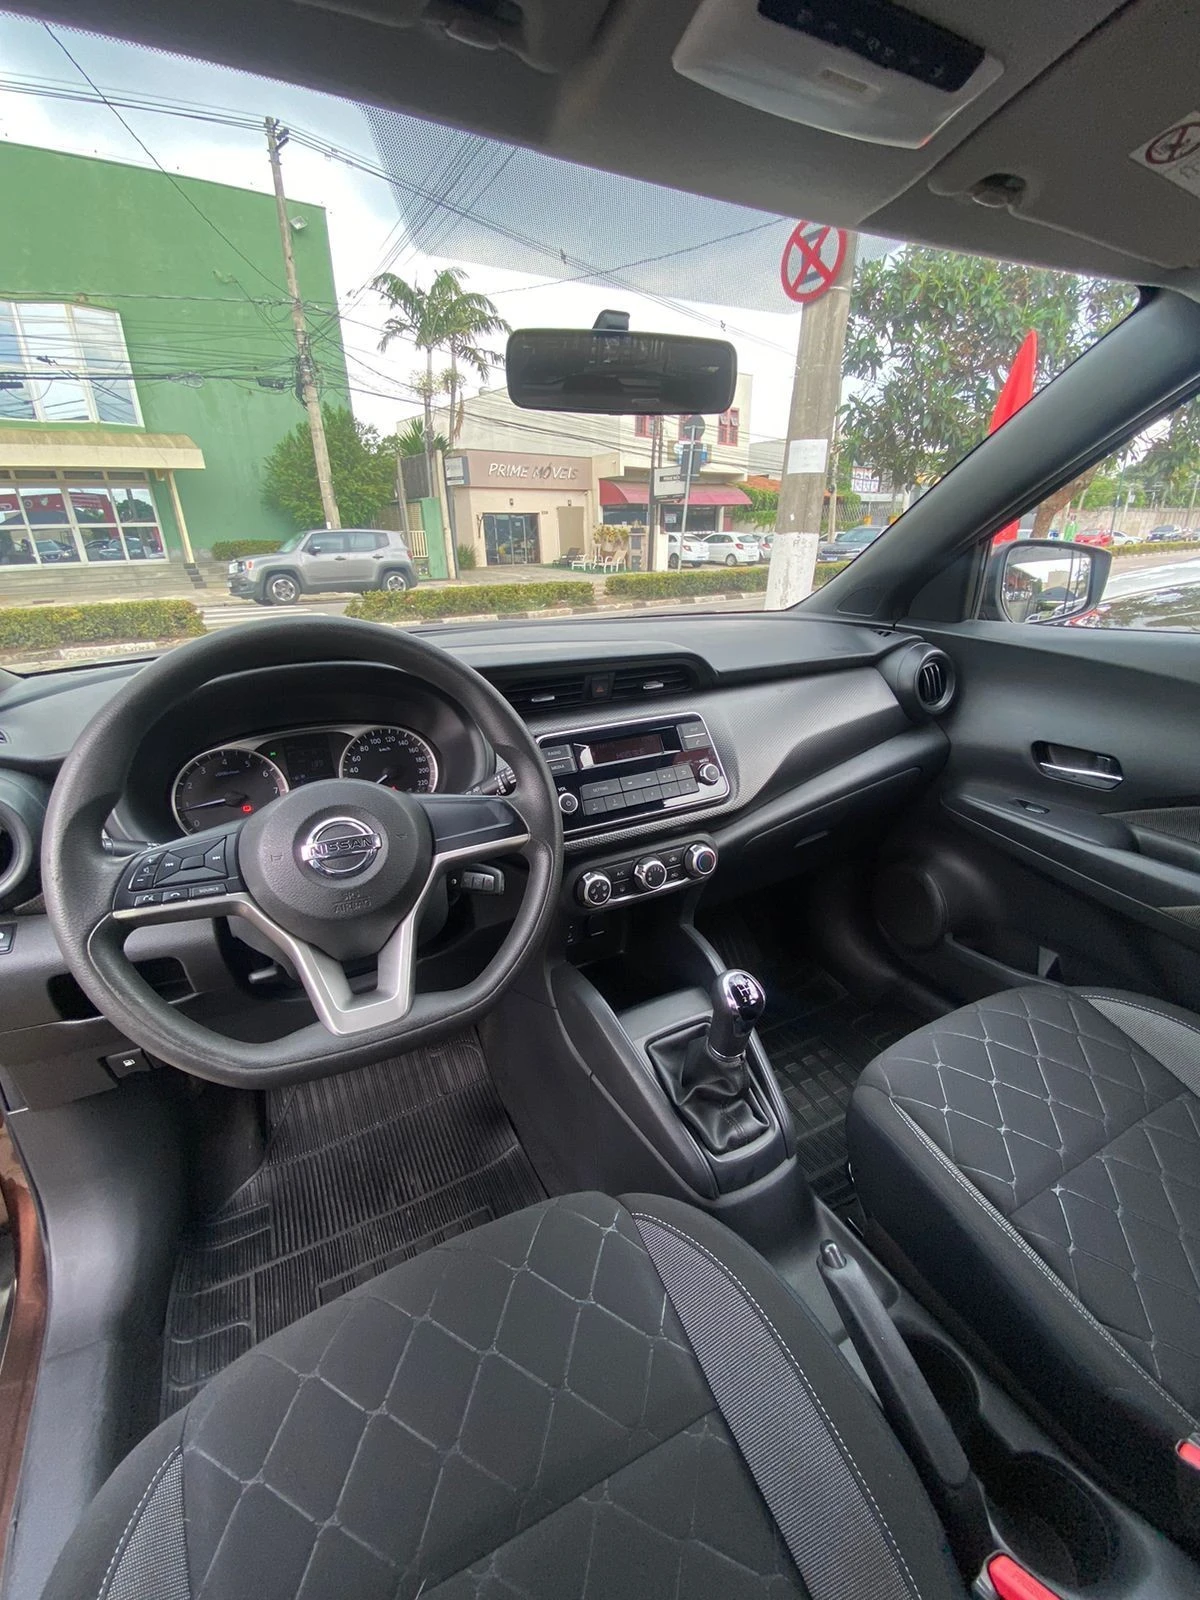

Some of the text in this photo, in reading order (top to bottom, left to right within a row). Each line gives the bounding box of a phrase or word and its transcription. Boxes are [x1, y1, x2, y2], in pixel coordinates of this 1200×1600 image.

[488, 462, 579, 480] PRIME MÓVEIS
[262, 770, 269, 778] 6
[310, 837, 373, 856] NISSAN
